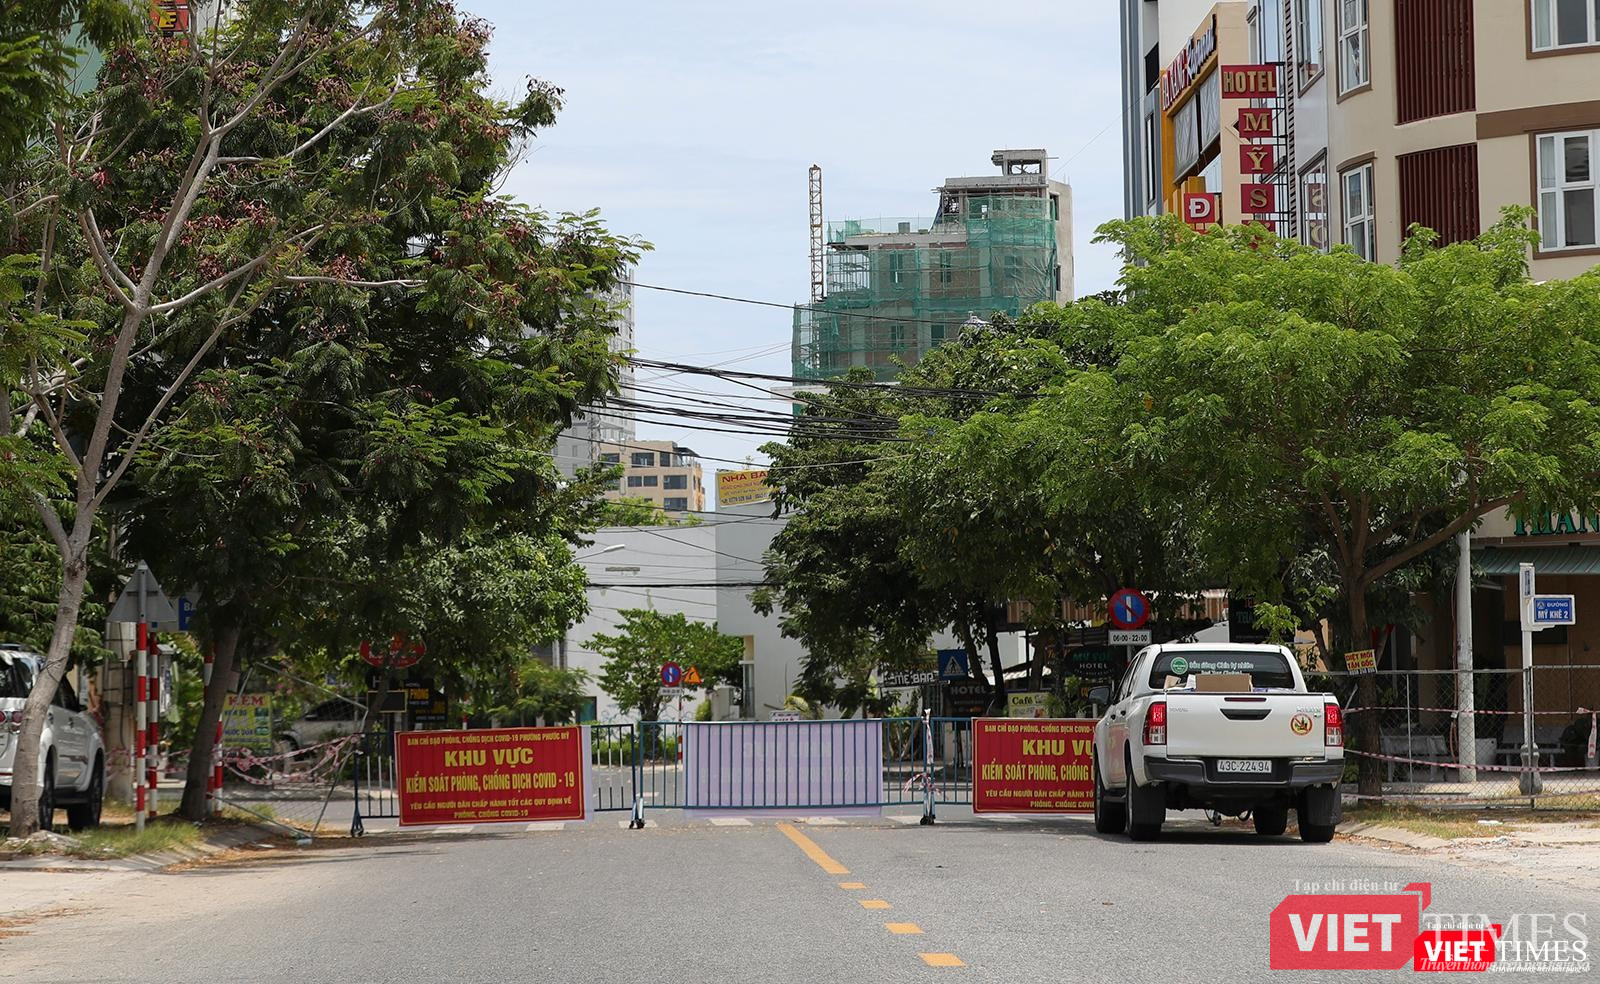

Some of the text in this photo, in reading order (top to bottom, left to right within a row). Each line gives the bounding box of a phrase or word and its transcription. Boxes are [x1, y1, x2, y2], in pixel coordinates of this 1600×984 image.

[1223, 70, 1277, 93] HOTEL
[1250, 188, 1268, 208] S
[1537, 609, 1568, 619] MỸ KHÊ 2
[951, 686, 985, 694] HOTEL
[228, 696, 264, 706] KEM
[1041, 723, 1059, 732] CHỐNG
[1061, 726, 1073, 734] DỊCH
[495, 734, 519, 742] COVID-19
[1023, 739, 1065, 755] KHU
[445, 747, 533, 768] KHU VỰC
[982, 758, 1003, 780] KIỂM
[1005, 761, 1026, 780] SOÁT
[1028, 761, 1058, 782] PHÒNG,
[1061, 759, 1088, 780] CHỐNG
[406, 771, 426, 793] KIỂM
[428, 773, 449, 792] SOÁT
[451, 771, 481, 791] PHÒNG,
[483, 769, 510, 791] CHỐNG
[512, 773, 531, 792] DỊCH
[533, 772, 557, 788] COVID
[565, 771, 574, 787] 19
[1055, 800, 1077, 808] CHỐNG
[501, 809, 528, 817] COVID-19
